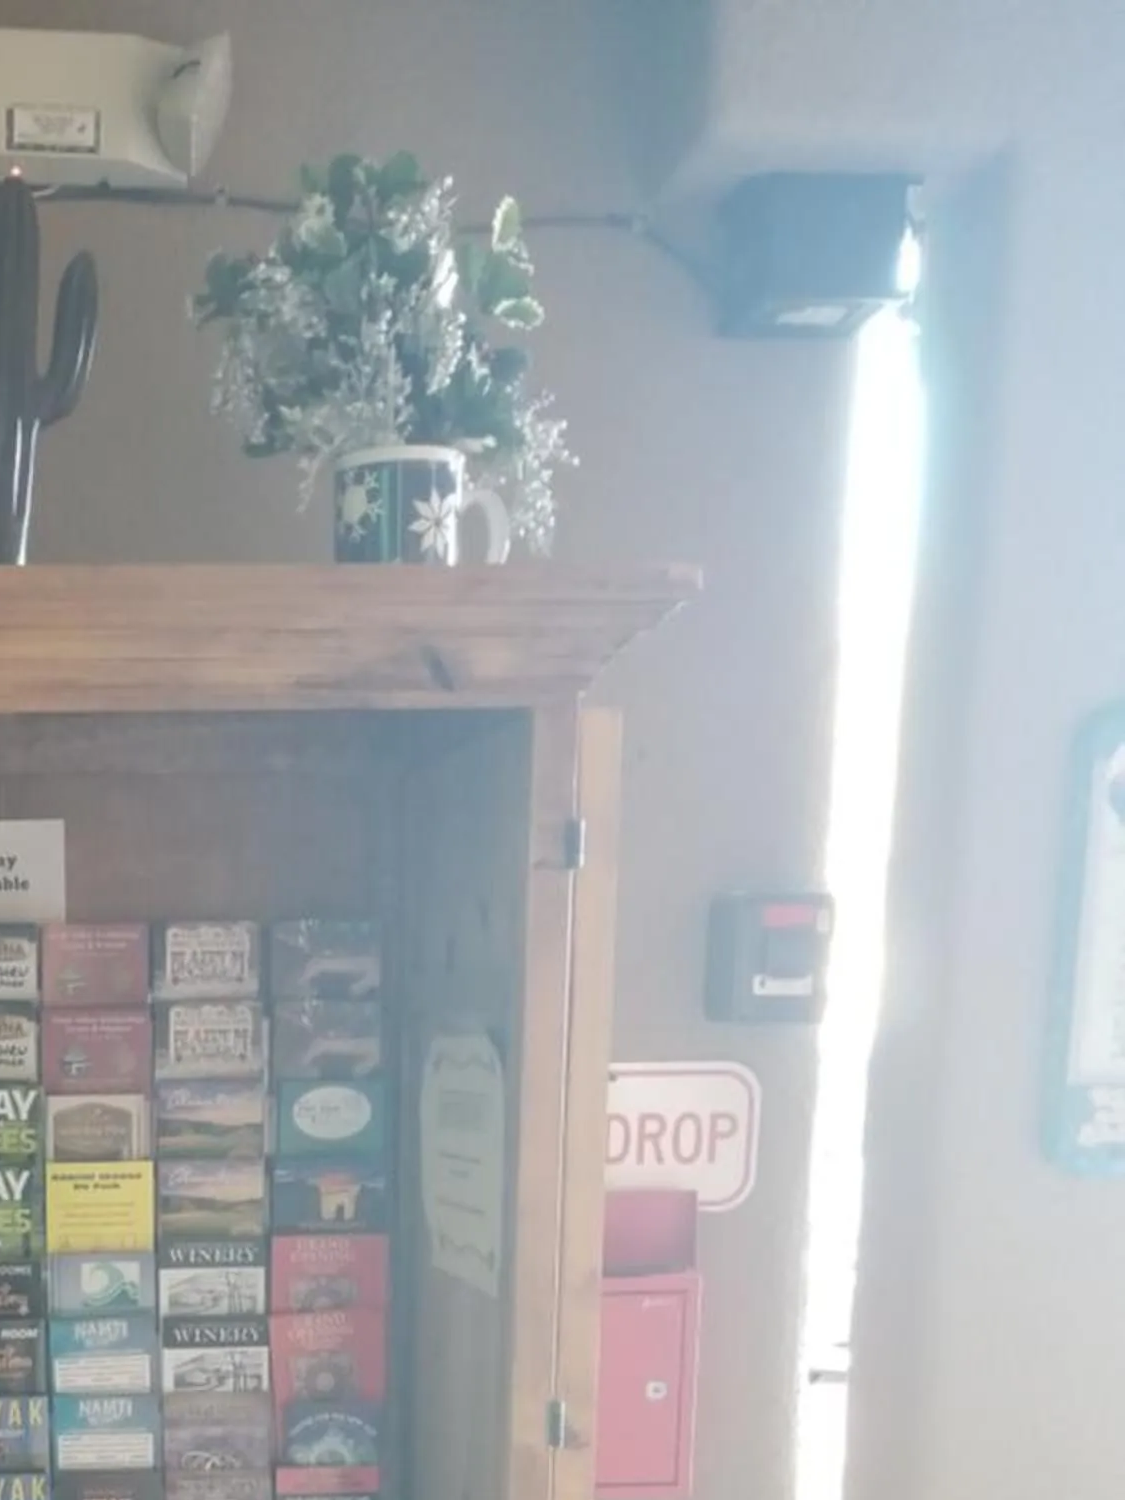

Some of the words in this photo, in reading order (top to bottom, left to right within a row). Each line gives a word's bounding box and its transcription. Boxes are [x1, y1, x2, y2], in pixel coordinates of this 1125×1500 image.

[605, 1111, 740, 1166] DROP
[169, 1246, 258, 1264] WINERY
[173, 1326, 260, 1343] WINERY
